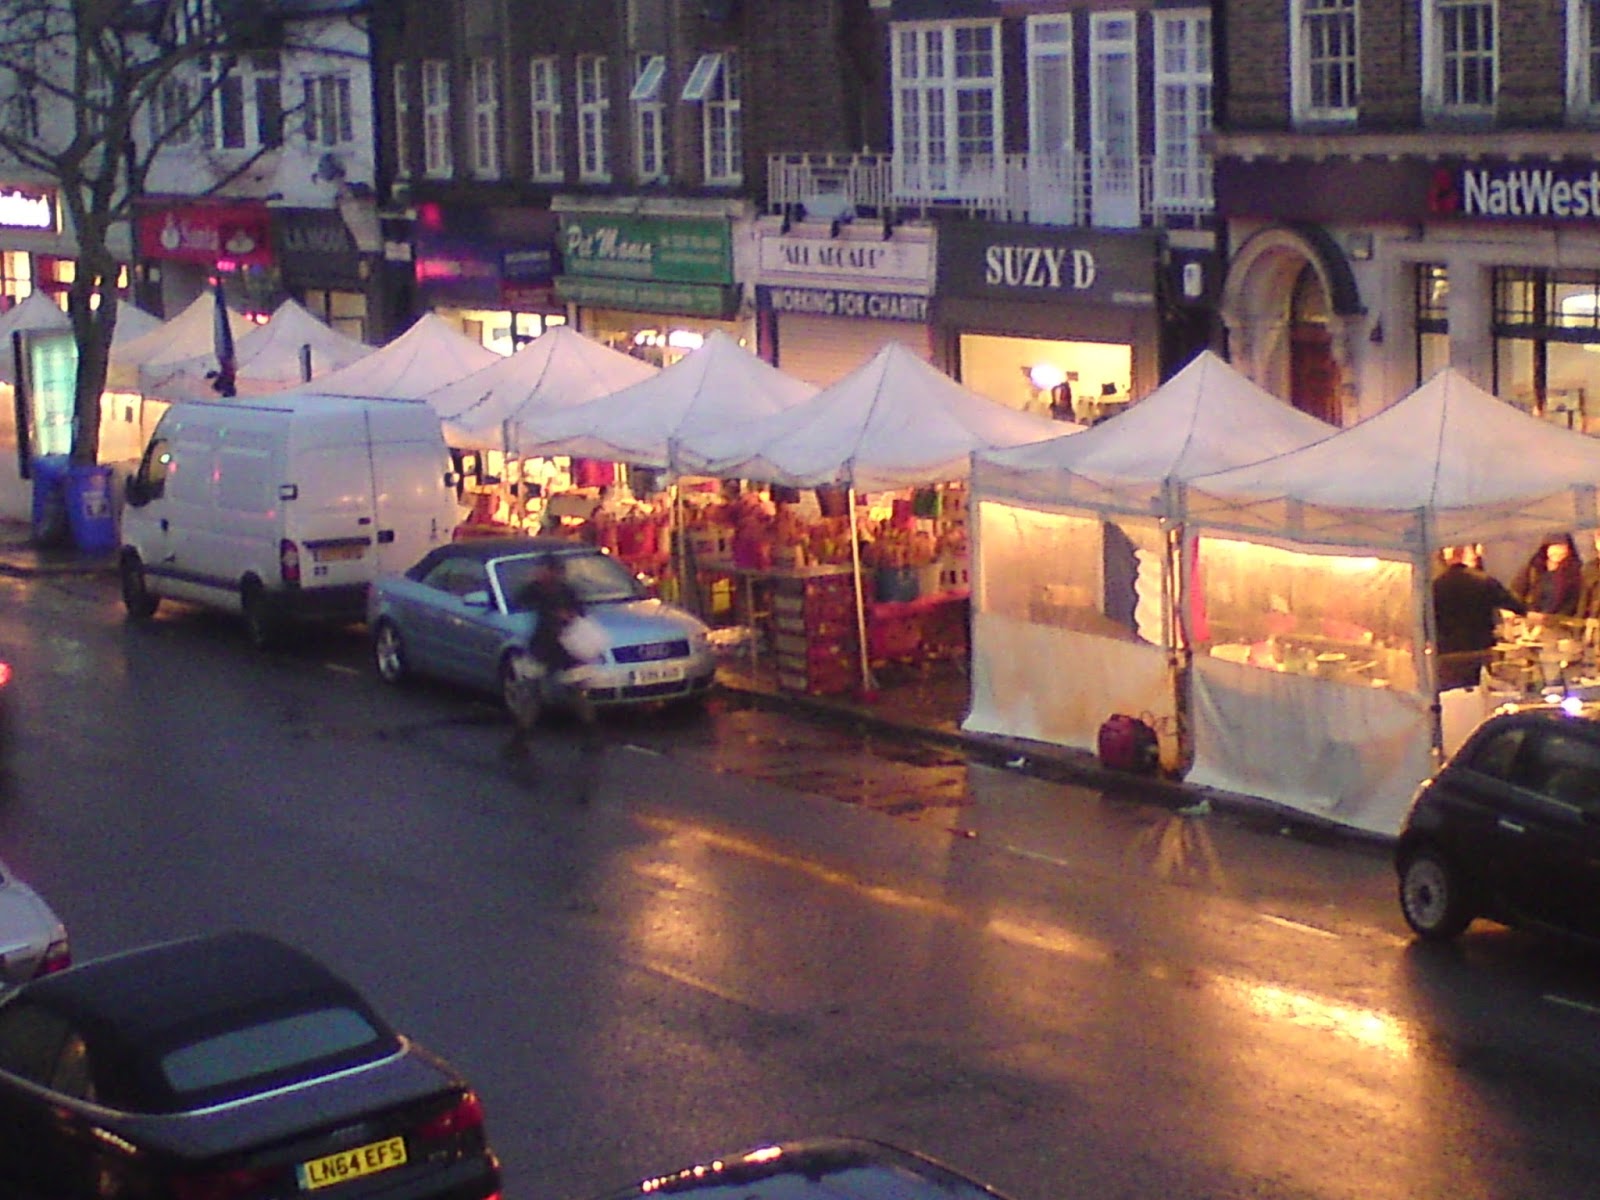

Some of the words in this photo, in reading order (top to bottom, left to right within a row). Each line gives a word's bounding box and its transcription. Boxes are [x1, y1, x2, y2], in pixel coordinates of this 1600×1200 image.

[1464, 170, 1600, 216] NatWest
[986, 246, 1066, 287] SUZY
[1073, 249, 1096, 289] D
[771, 289, 835, 315] WORKING
[839, 292, 866, 316] FOR
[868, 294, 928, 321] CHARITY
[308, 1154, 361, 1184] LN64
[364, 1141, 403, 1168] EFS
